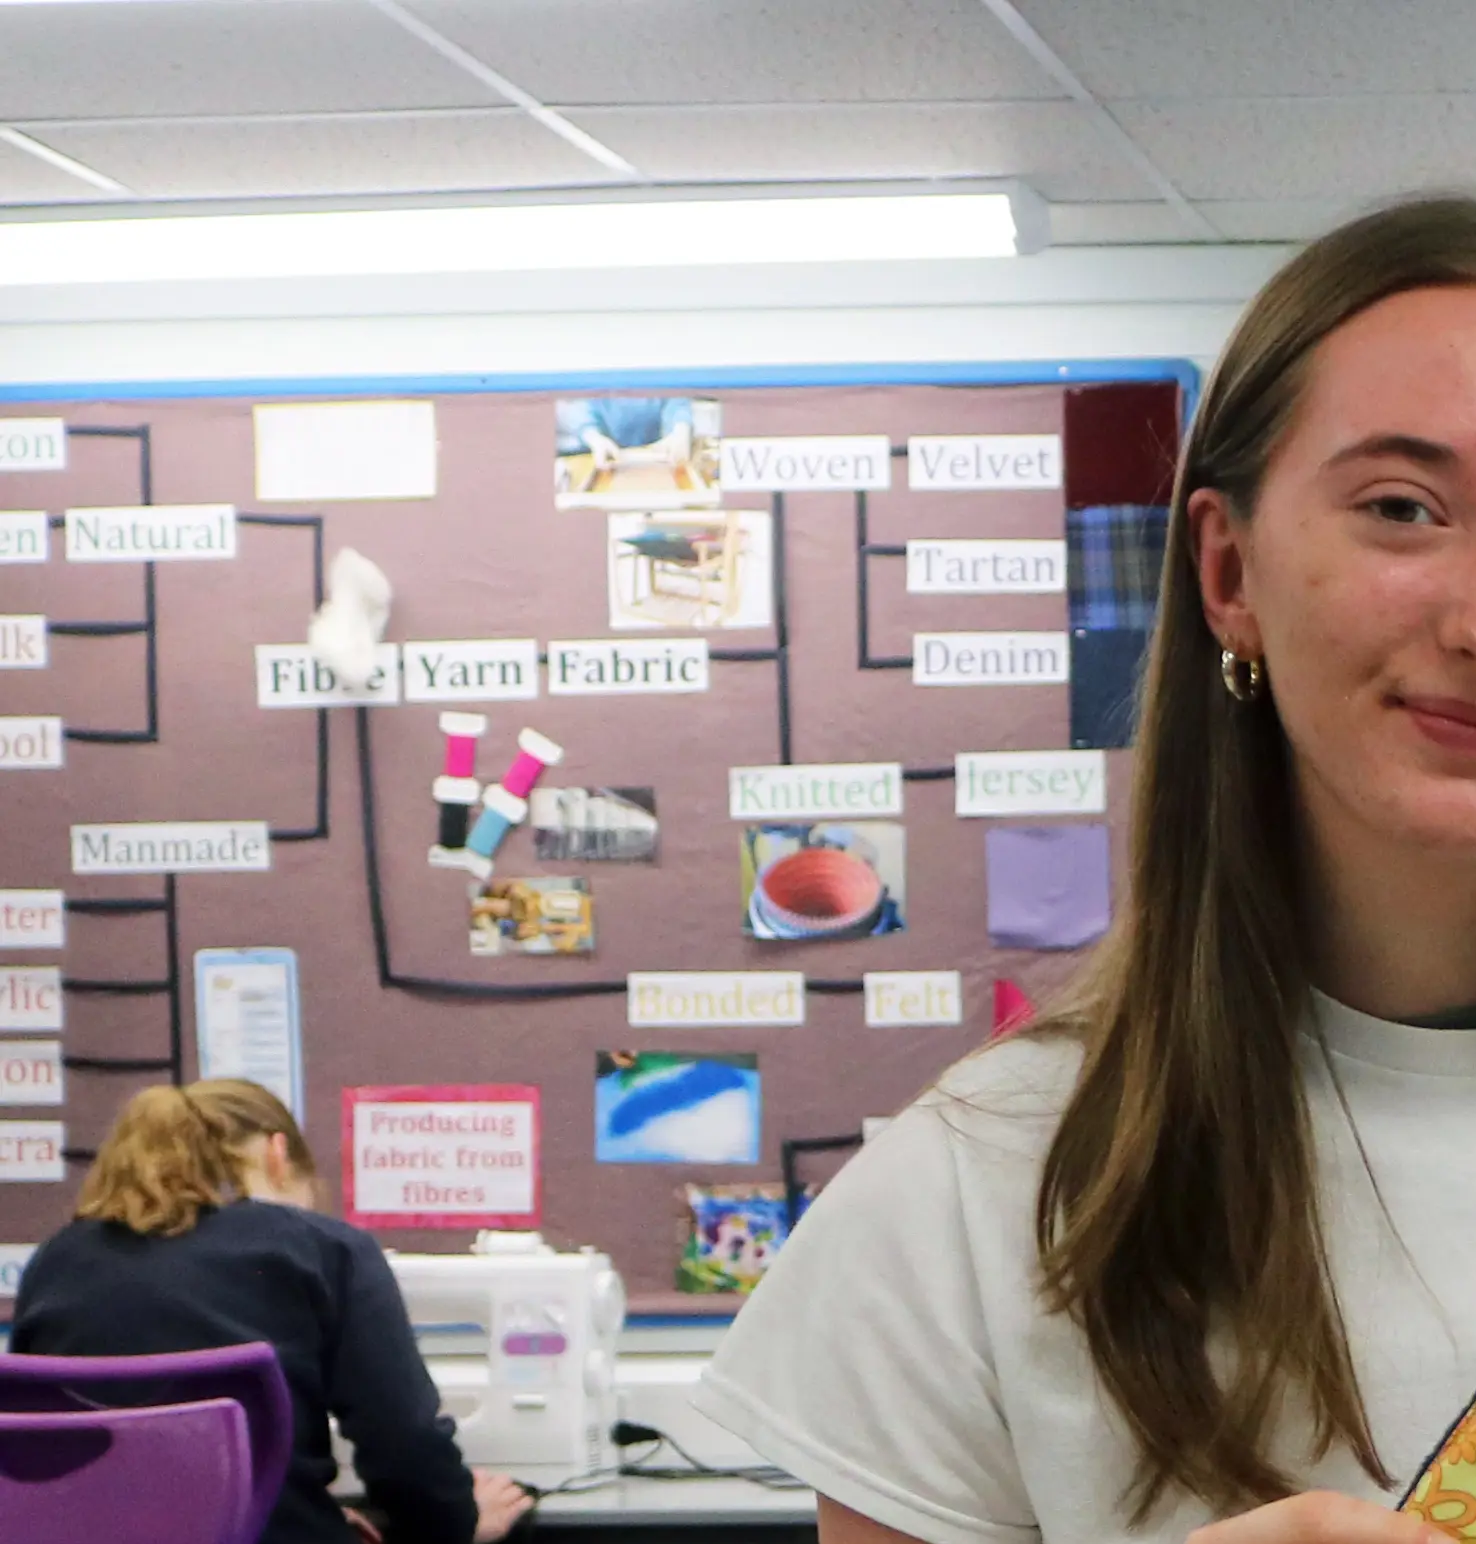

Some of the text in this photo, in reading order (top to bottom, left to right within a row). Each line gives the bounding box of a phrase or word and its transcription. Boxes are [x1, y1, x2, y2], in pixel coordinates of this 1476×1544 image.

[729, 444, 876, 482] Woven
[920, 444, 1052, 481] Velvet
[74, 516, 228, 553] Natural
[914, 547, 1057, 584] Tartan
[270, 656, 386, 693] Fibe
[419, 654, 524, 688] Yarn
[558, 649, 700, 684] Fabric
[923, 639, 1061, 676] Denim
[737, 770, 894, 812] Knitted
[966, 760, 1096, 804] Jersey
[80, 829, 261, 865] Manmade
[636, 980, 796, 1018] Bonded
[873, 981, 951, 1018] Felt
[370, 1109, 516, 1139] Producing
[362, 1146, 526, 1170] fabric from
[401, 1180, 486, 1205] fibres
